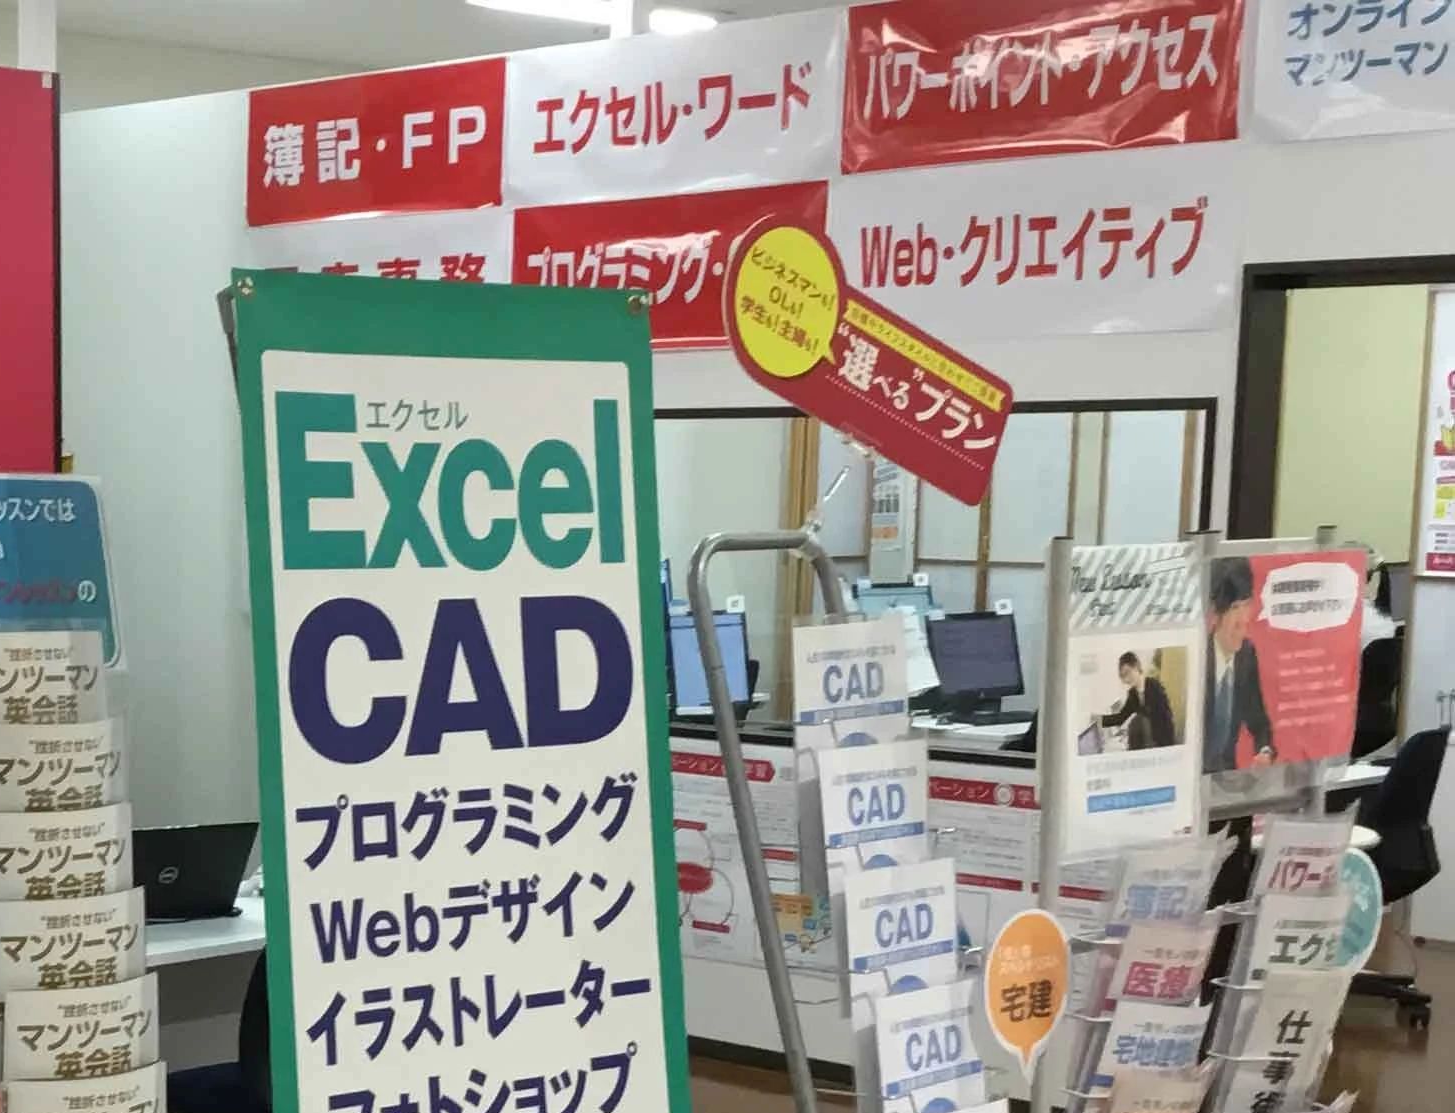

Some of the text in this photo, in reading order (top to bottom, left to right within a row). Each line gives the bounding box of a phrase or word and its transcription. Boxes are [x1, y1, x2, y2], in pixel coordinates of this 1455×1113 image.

[1285, 41, 1449, 87] マンツーマン
[532, 61, 813, 155] エクセル・ワード
[861, 196, 1208, 288] Web・クリエイティブ
[365, 399, 468, 432] エクセル
[275, 390, 625, 571] Excel
[288, 595, 634, 765] CAD
[823, 661, 885, 703] CAD
[2, 695, 80, 726] 英会話
[295, 771, 638, 871] プログラミング
[848, 783, 906, 827] CAD
[310, 871, 636, 964] Webデザイン
[875, 903, 934, 949] CAD
[0, 923, 139, 964] マンツーマン
[306, 960, 652, 1066] イラストレーター
[1001, 978, 1053, 1022] 宅建
[16, 1008, 154, 1052] マンツーマン
[904, 1024, 962, 1072] CAD
